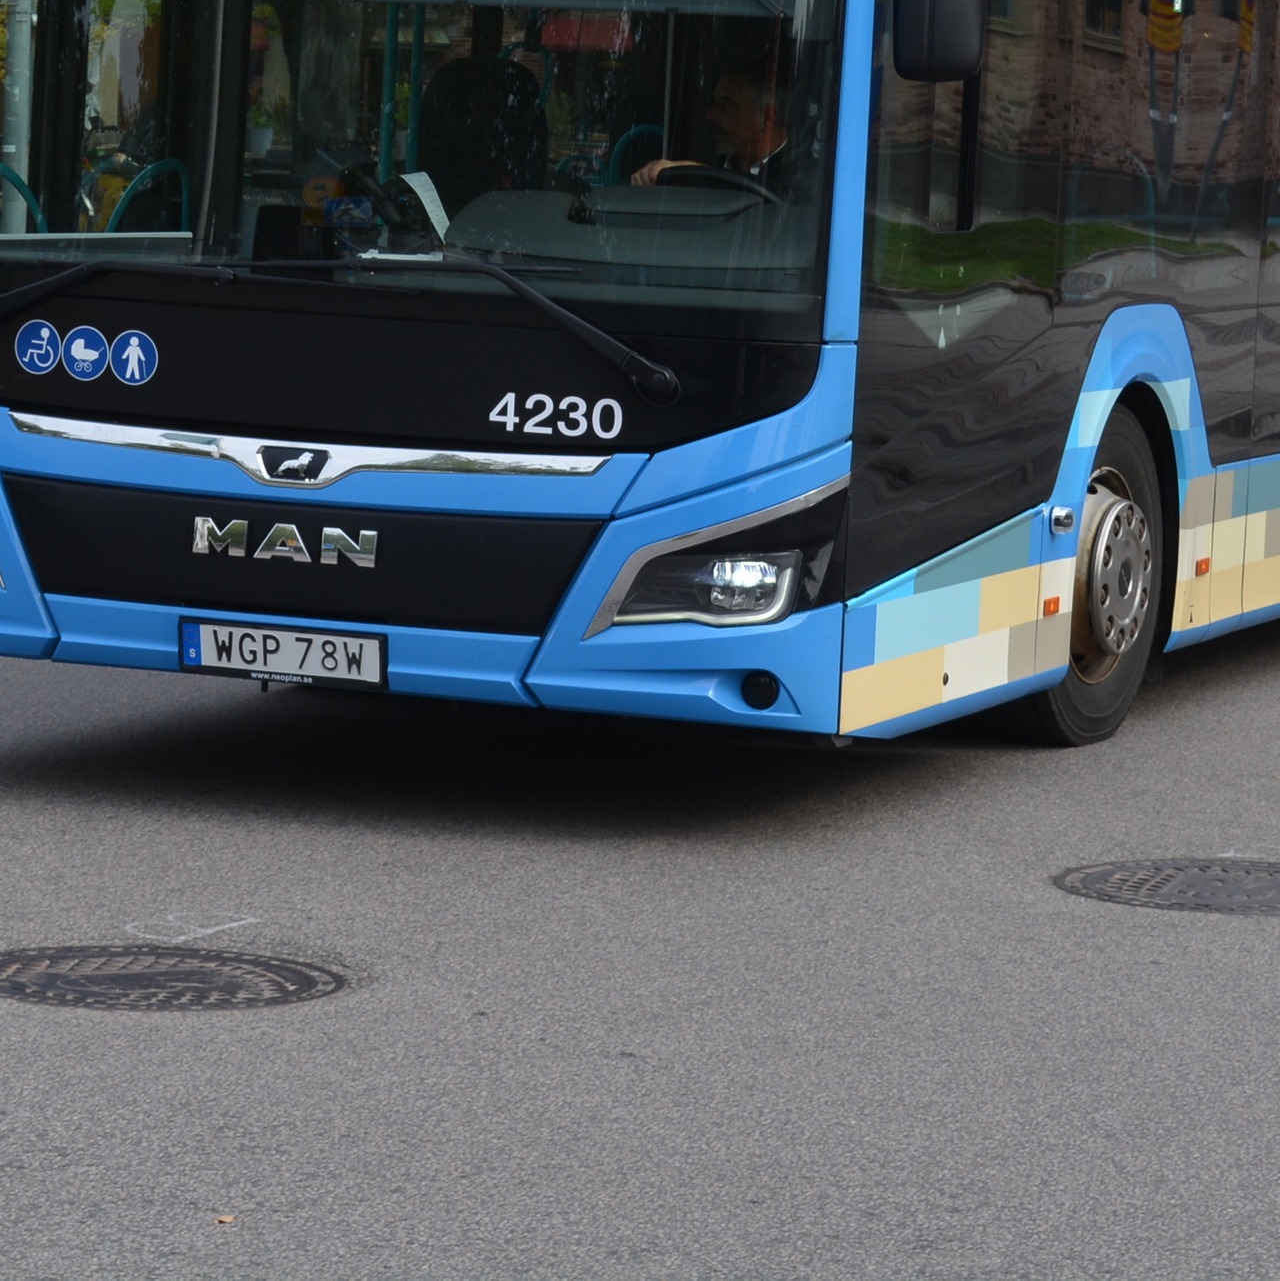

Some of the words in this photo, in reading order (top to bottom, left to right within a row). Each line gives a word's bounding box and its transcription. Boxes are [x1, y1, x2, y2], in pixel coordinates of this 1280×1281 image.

[489, 392, 623, 439] 4230
[192, 516, 378, 568] MAN
[189, 648, 197, 659] S
[213, 629, 280, 667] WGP
[295, 636, 363, 675] 78W
[250, 671, 313, 684] www.neoplan.se
